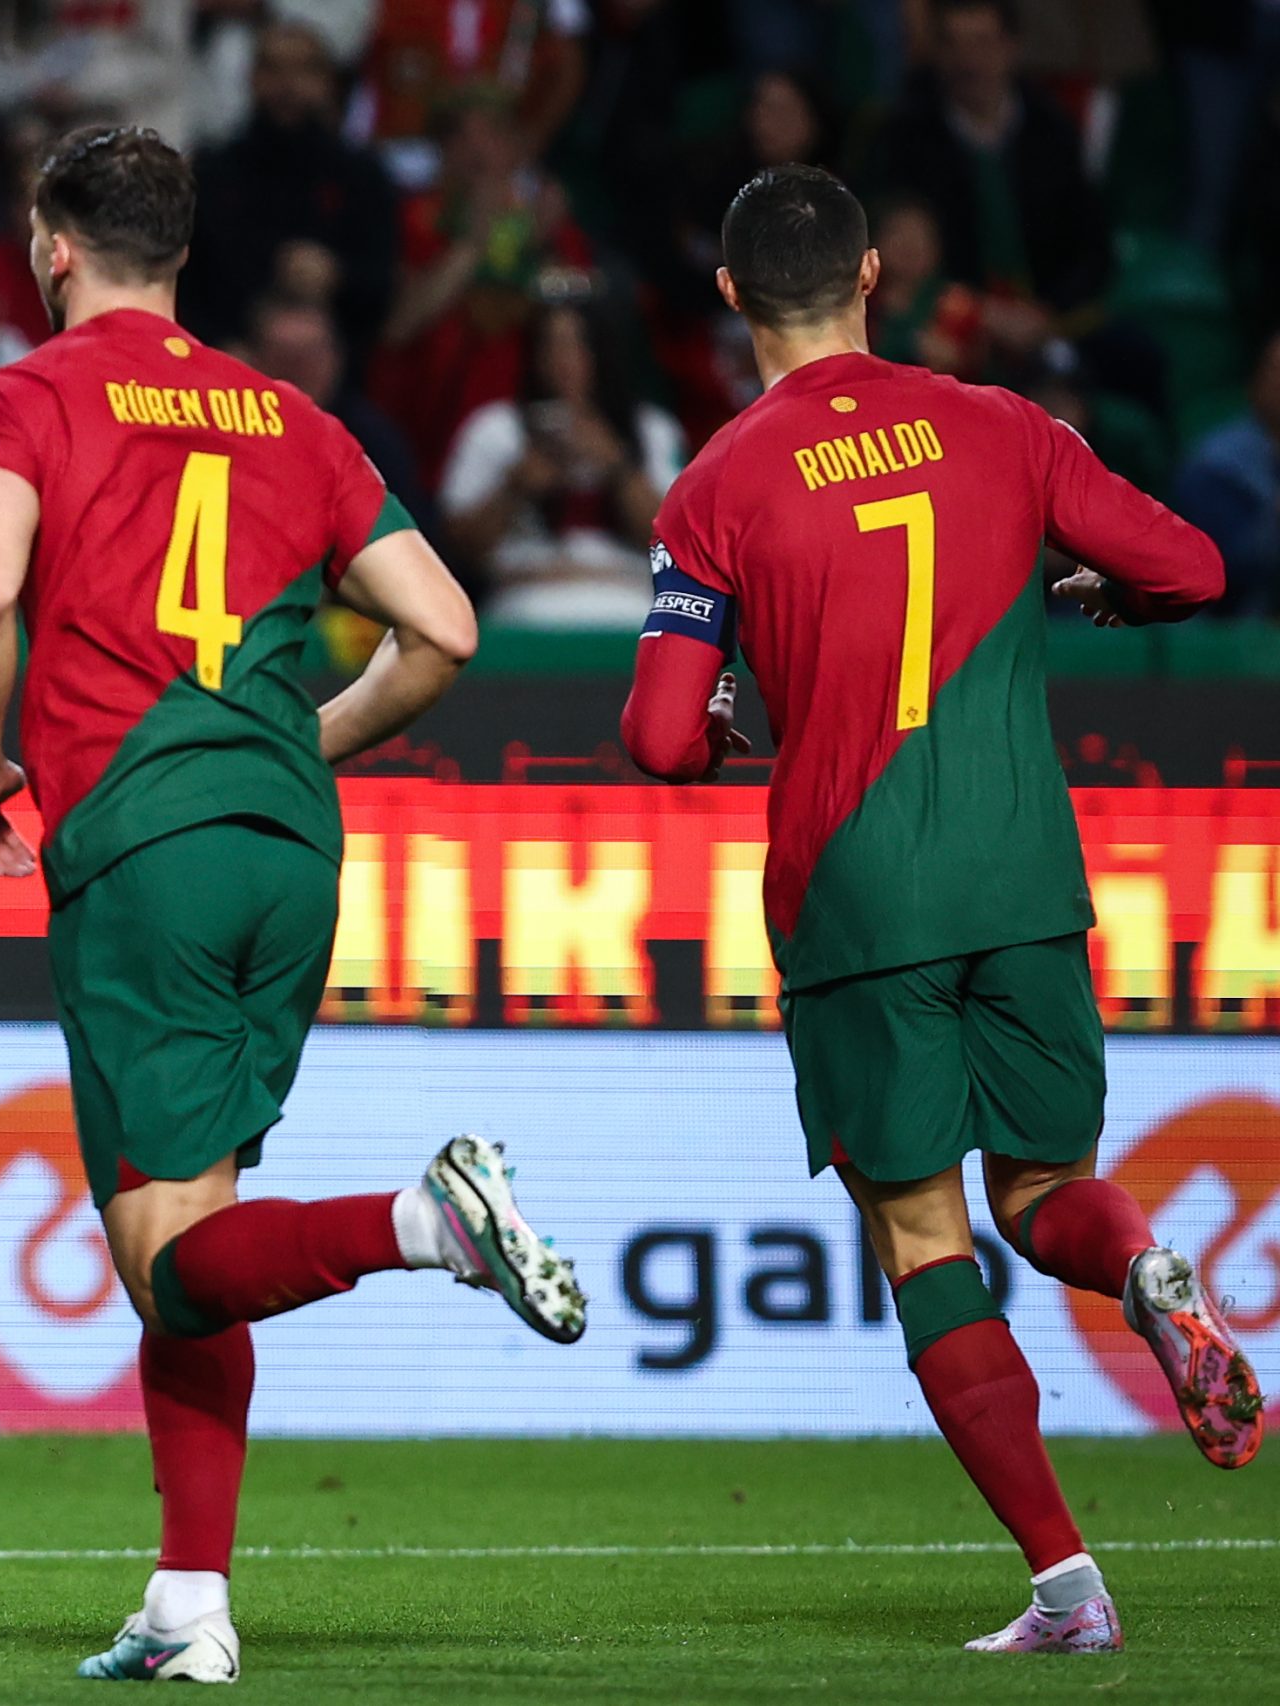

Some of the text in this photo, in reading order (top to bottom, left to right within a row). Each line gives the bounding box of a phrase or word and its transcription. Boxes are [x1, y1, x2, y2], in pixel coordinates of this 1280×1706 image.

[105, 379, 285, 437] RÚBEN DIAS
[793, 419, 944, 491] RONALDO
[155, 451, 243, 691] 4
[853, 491, 935, 731] 7
[622, 1205, 1012, 1370] gal
